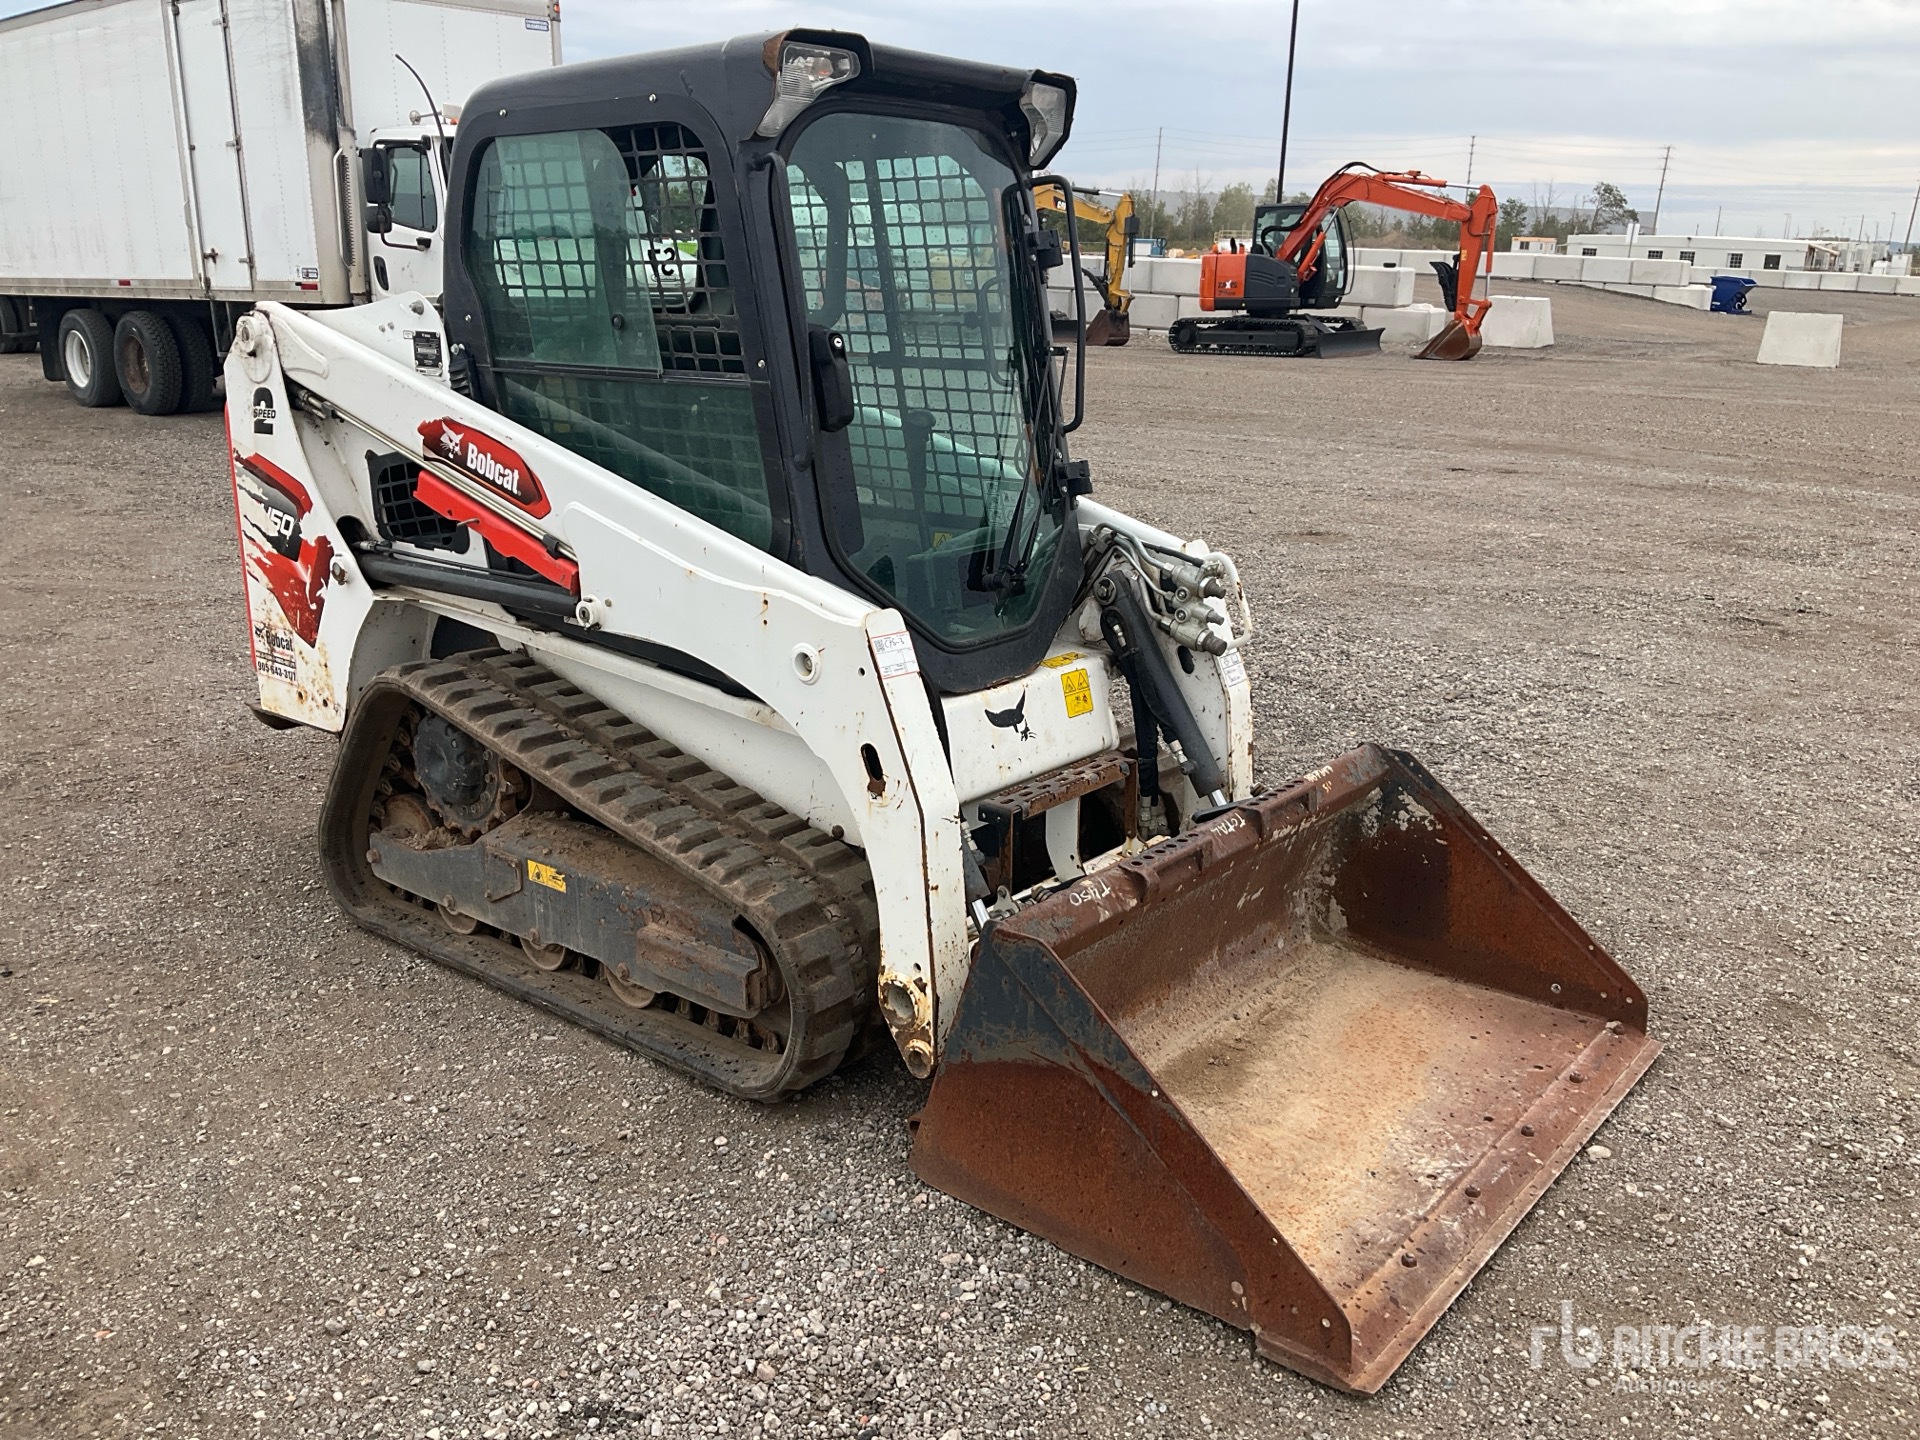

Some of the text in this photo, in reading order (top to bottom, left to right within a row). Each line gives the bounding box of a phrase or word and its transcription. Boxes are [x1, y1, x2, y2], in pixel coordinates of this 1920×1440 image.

[253, 387, 273, 435] 2
[253, 409, 276, 419] SPEED
[466, 442, 520, 496] Bobcat
